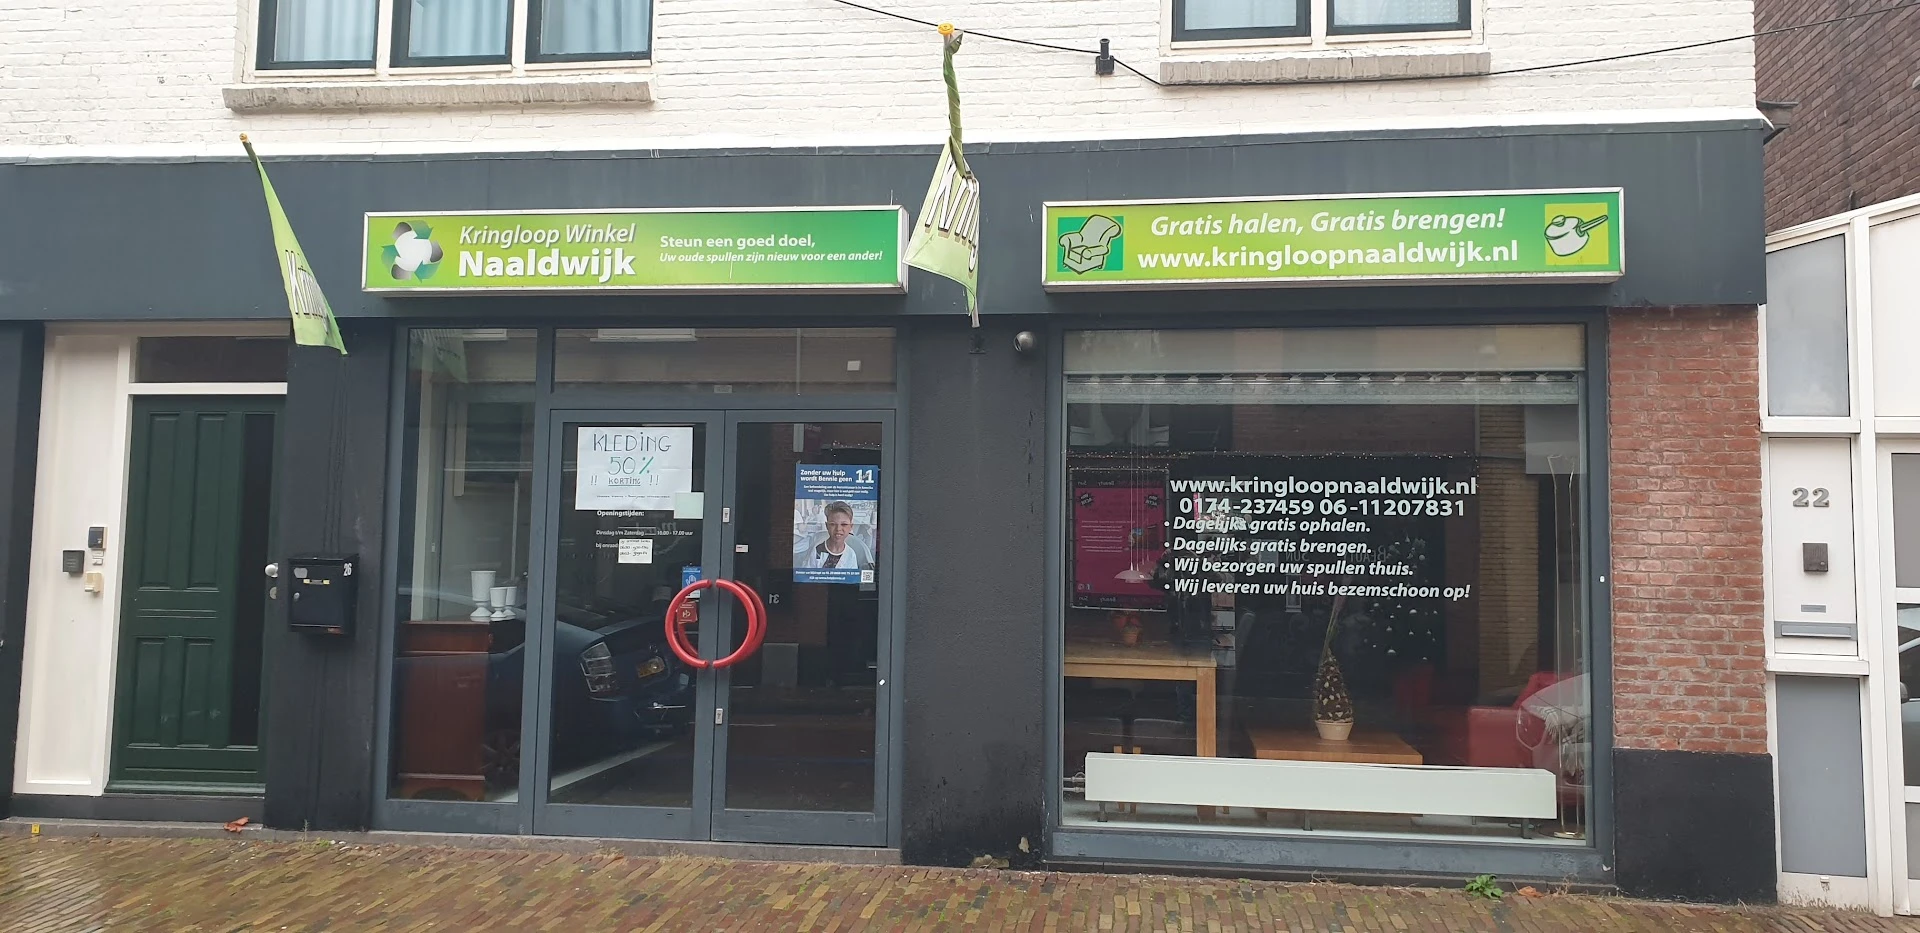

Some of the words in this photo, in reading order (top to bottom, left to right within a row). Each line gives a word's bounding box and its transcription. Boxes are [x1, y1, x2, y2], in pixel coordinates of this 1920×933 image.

[1151, 214, 1223, 236] Gratis
[1228, 213, 1304, 238] halen,
[1310, 210, 1386, 232] Gratis
[1392, 208, 1506, 235] brengen!
[459, 224, 560, 249] Kringloop
[565, 222, 636, 246] Winkel
[660, 235, 703, 248] Steun
[706, 238, 733, 248] een
[736, 234, 775, 253] goed
[778, 233, 816, 250] doel,
[459, 247, 636, 284] Naaldwijk
[659, 252, 677, 262] Uw
[679, 251, 705, 262] oude
[707, 251, 744, 266] spullen
[745, 251, 765, 265] zijn
[767, 251, 799, 261] nieuw
[801, 252, 825, 261] voor
[827, 252, 846, 261] een
[848, 250, 883, 261] ander!
[1137, 240, 1519, 271] www.kringloopnaaldwijk.nl
[593, 431, 672, 452] KLEDING
[832, 469, 846, 477] hulp
[1170, 475, 1477, 499] www.kringloopnaaldwijk.nl
[1792, 487, 1830, 508] 22
[596, 510, 645, 518] Openingstijden:
[623, 529, 645, 537] Zaterdag
[1173, 516, 1247, 535] Dagelijks
[1250, 517, 1297, 535] gratis
[1299, 516, 1371, 536] ophalen.
[1173, 536, 1247, 555] Dagelijks
[1250, 537, 1297, 555] gratis
[1300, 538, 1371, 557] brengen.
[343, 562, 353, 577] 26
[1174, 557, 1200, 576] Wij
[1202, 556, 1276, 577] bezorgen
[1279, 562, 1304, 574] uw
[1306, 560, 1365, 578] spullen
[1368, 560, 1414, 576] thuis.
[1174, 578, 1200, 596] Wij
[1202, 578, 1260, 594] leveren
[1263, 583, 1289, 595] uw
[1291, 580, 1324, 596] huis
[1328, 581, 1440, 598] bezemschoon
[1443, 583, 1471, 602] op!
